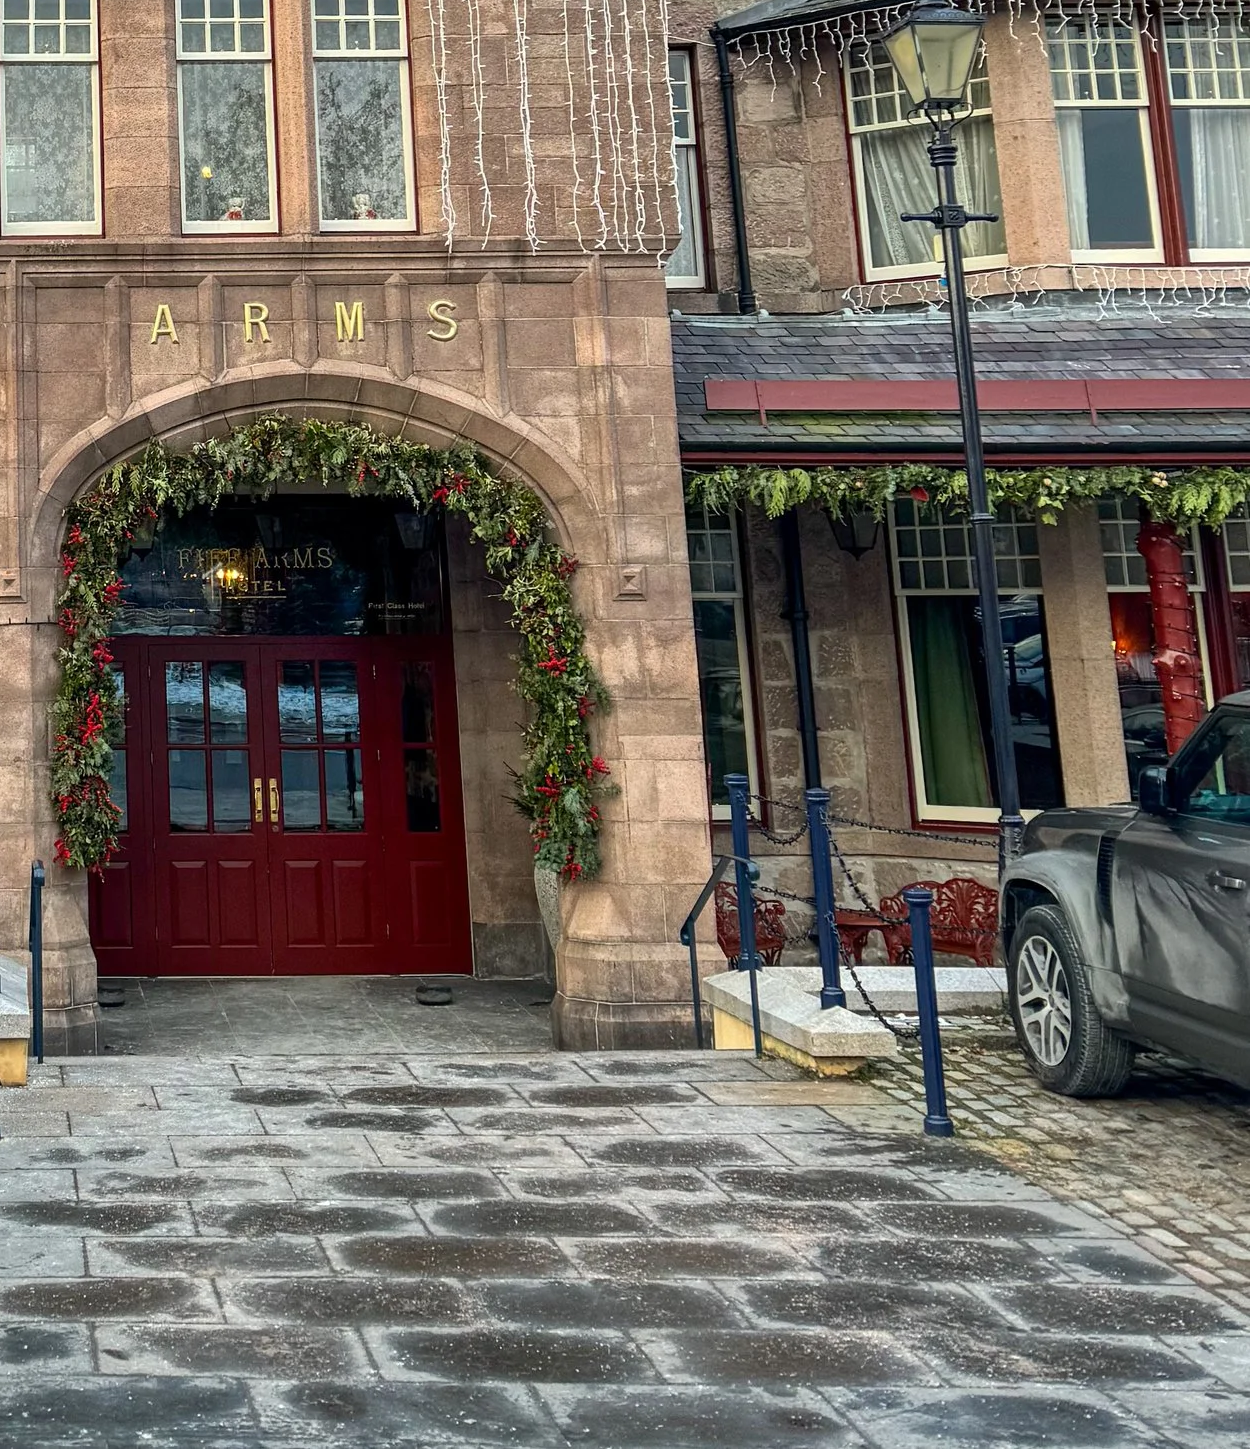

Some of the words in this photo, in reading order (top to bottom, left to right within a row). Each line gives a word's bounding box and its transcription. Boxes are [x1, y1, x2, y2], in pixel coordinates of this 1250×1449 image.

[150, 300, 459, 345] ARMS
[178, 548, 240, 569] FIFE
[255, 547, 333, 569] ARMS
